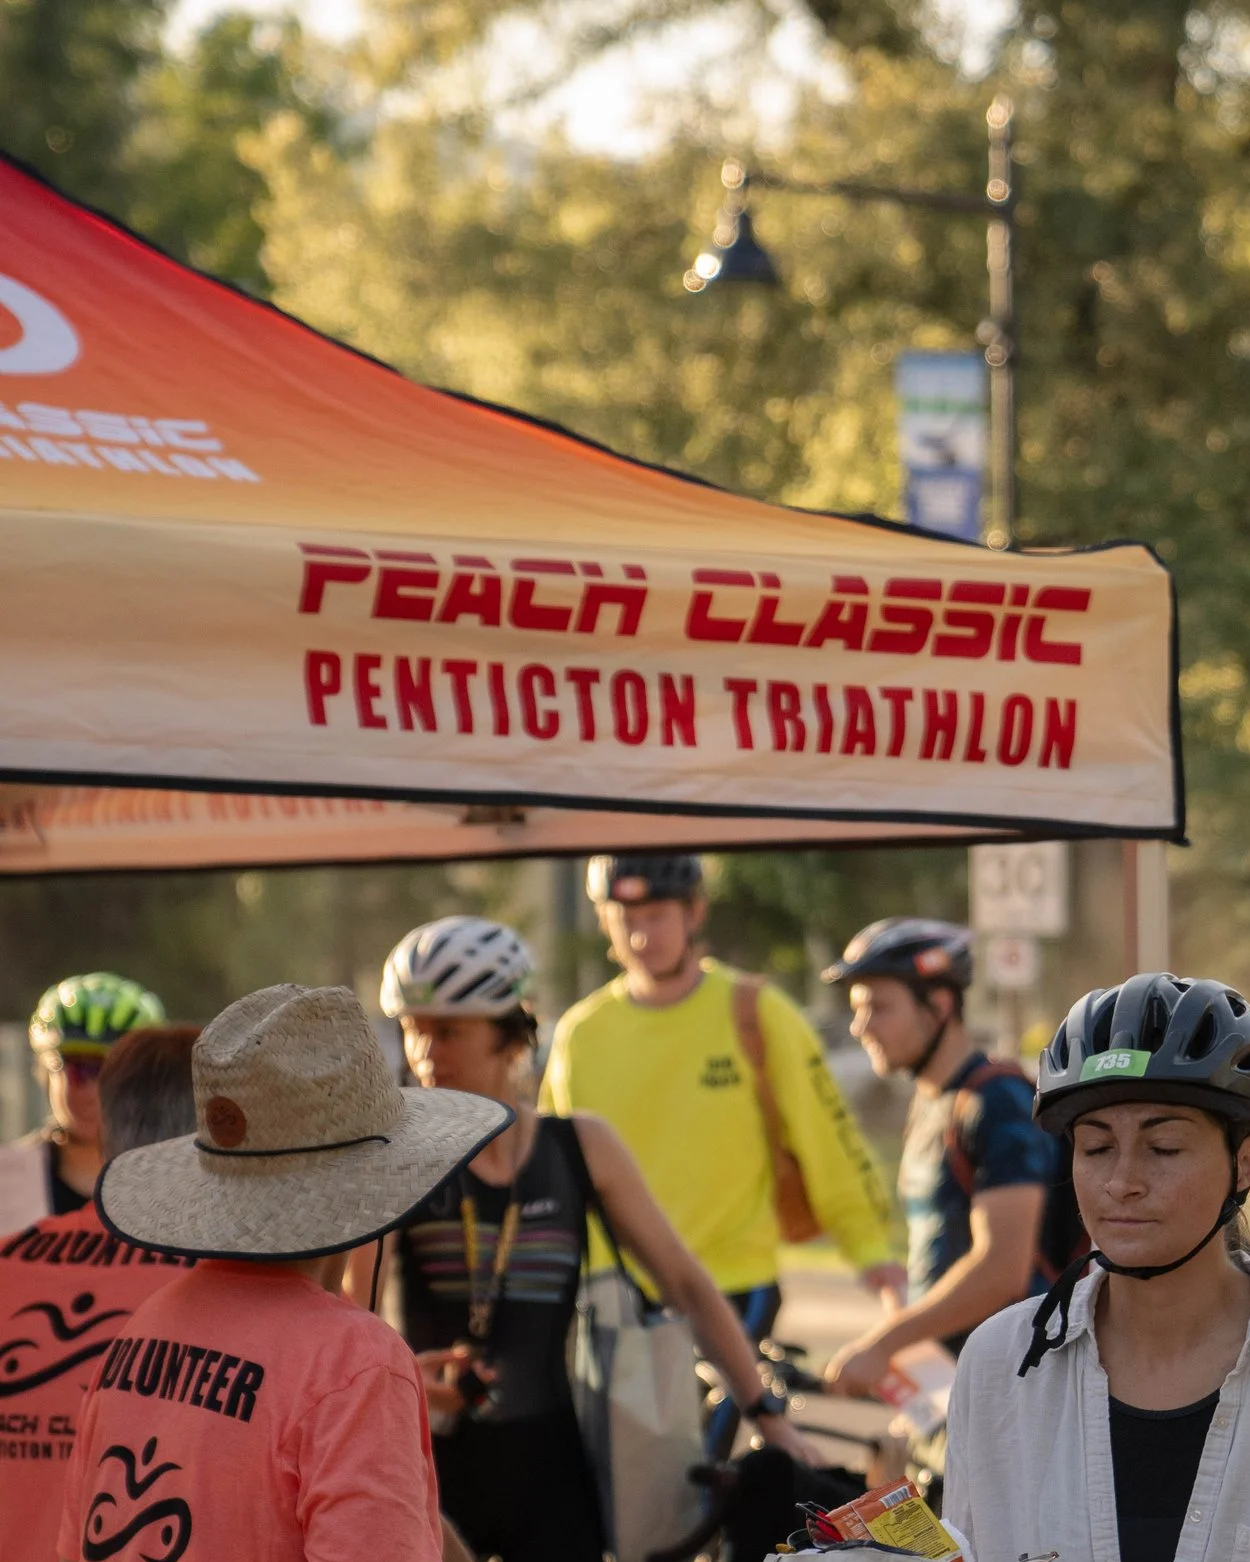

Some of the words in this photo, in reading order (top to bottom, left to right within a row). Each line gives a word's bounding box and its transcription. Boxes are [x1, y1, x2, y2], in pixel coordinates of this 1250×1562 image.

[297, 542, 648, 637] PEACH
[684, 567, 1092, 666] CLASSIC
[303, 649, 697, 747] PENTICTON
[722, 676, 1078, 770] TRIATHLON
[1094, 1053, 1131, 1072] 735
